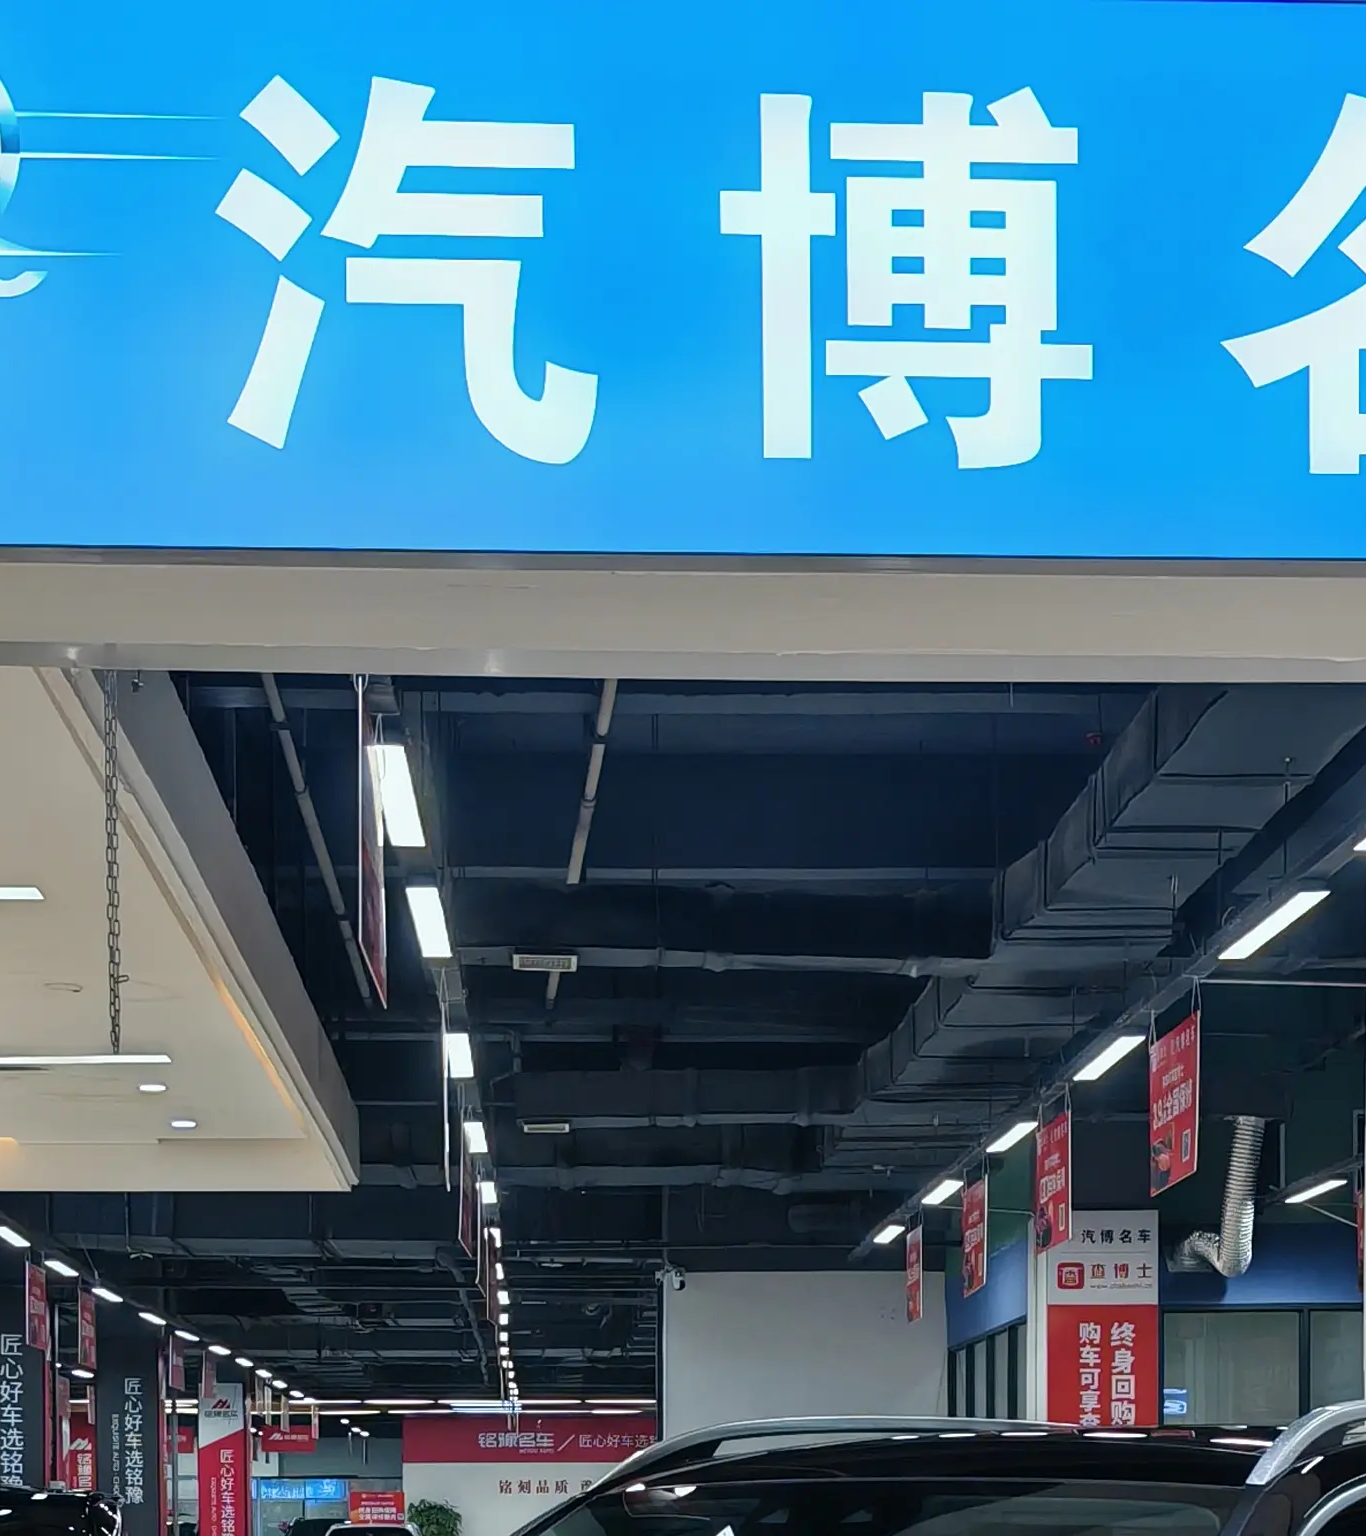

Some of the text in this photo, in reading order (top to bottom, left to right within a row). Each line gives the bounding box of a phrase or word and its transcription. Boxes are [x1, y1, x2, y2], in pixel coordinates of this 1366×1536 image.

[1081, 1229, 1152, 1244] 汽博名车
[1089, 1263, 1153, 1280] 查博士
[1110, 1322, 1136, 1427] 终身回购
[124, 1377, 144, 1505] 匠心好车选铭豫
[499, 1479, 569, 1495] 铭刻品质
